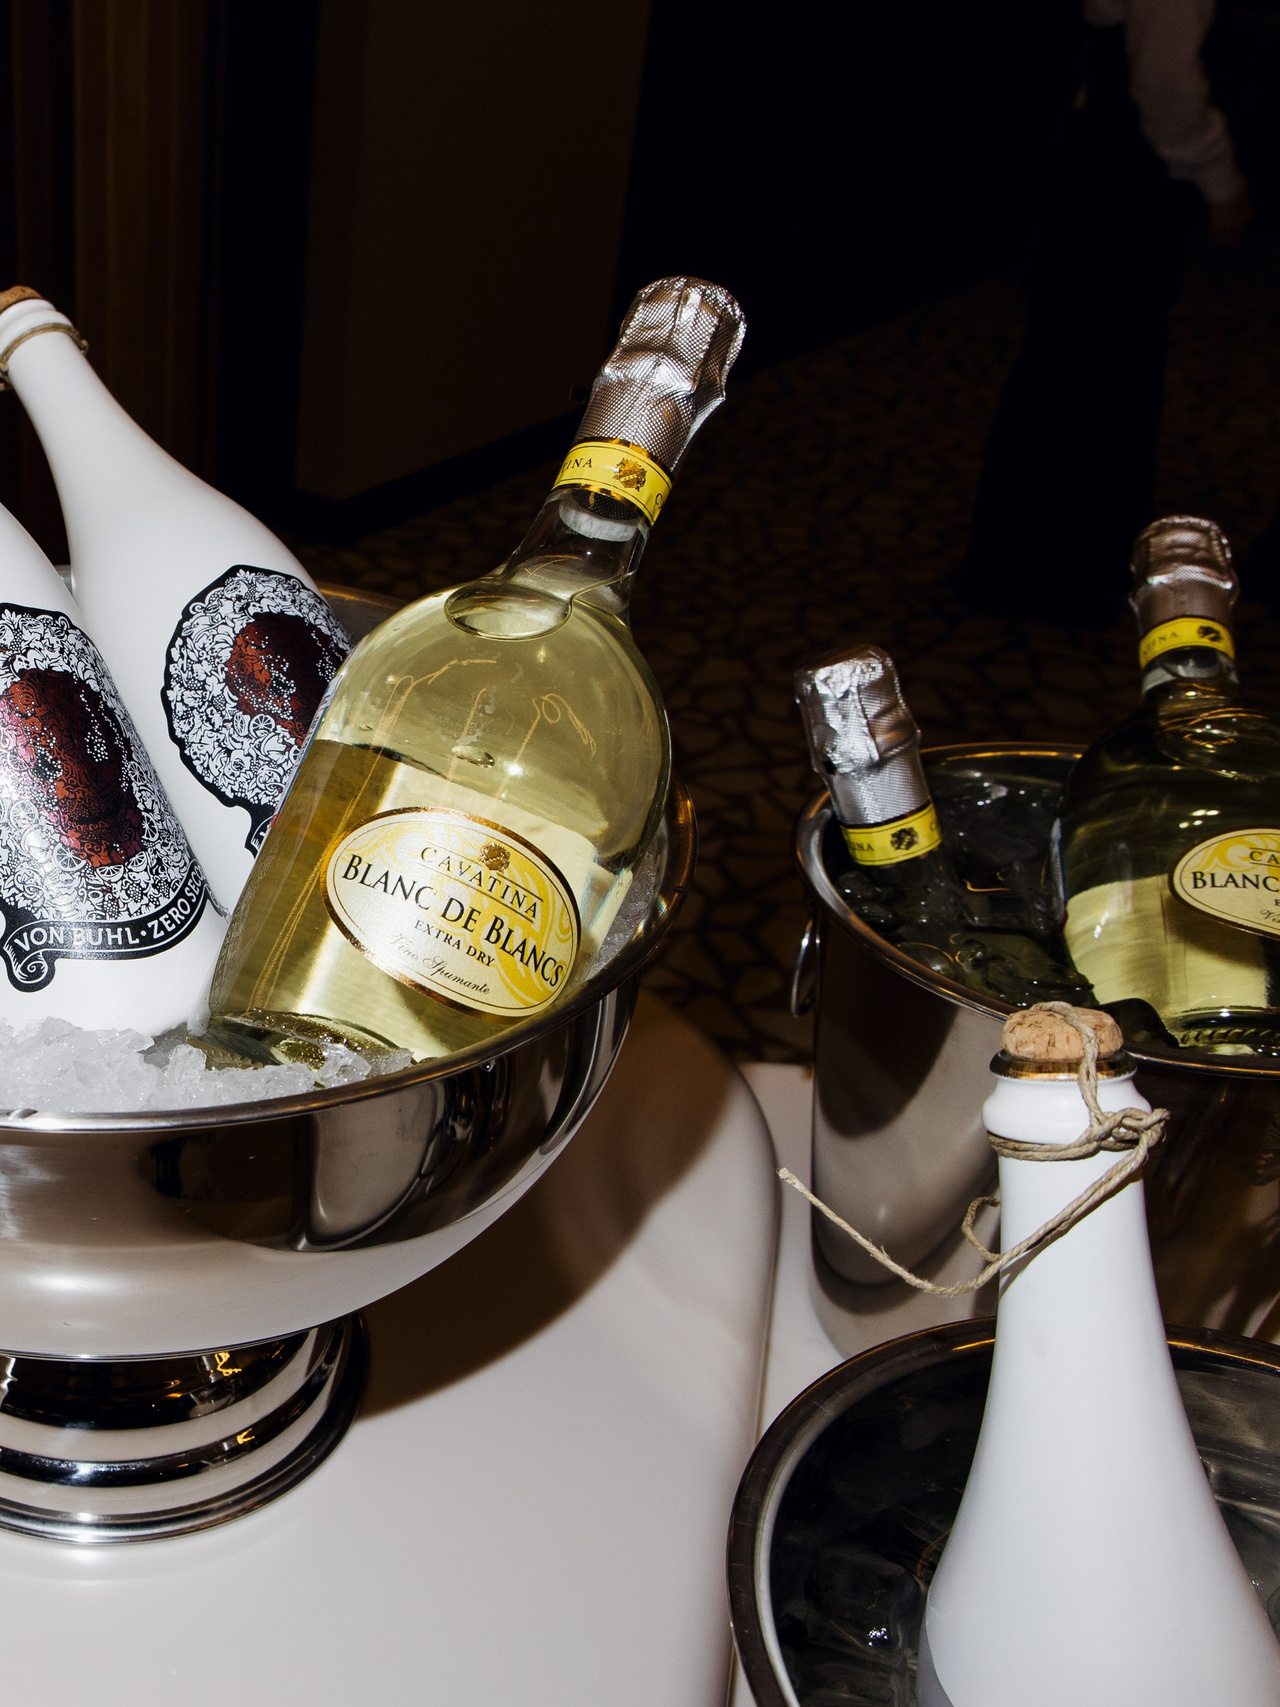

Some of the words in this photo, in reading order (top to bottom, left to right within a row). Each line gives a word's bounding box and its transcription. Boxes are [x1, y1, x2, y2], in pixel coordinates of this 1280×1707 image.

[421, 846, 538, 919] CAVATINA
[1192, 870, 1280, 893] BLANC
[14, 927, 64, 951] VON
[71, 926, 140, 946] BUHL
[148, 900, 192, 939] ZERO
[342, 854, 438, 910] BLANC
[441, 896, 481, 933] DE
[484, 915, 564, 987] BLANCS
[415, 919, 461, 951] EXTRA
[466, 945, 496, 967] DRY
[390, 930, 420, 962] Vino
[423, 955, 490, 995] Spumante
